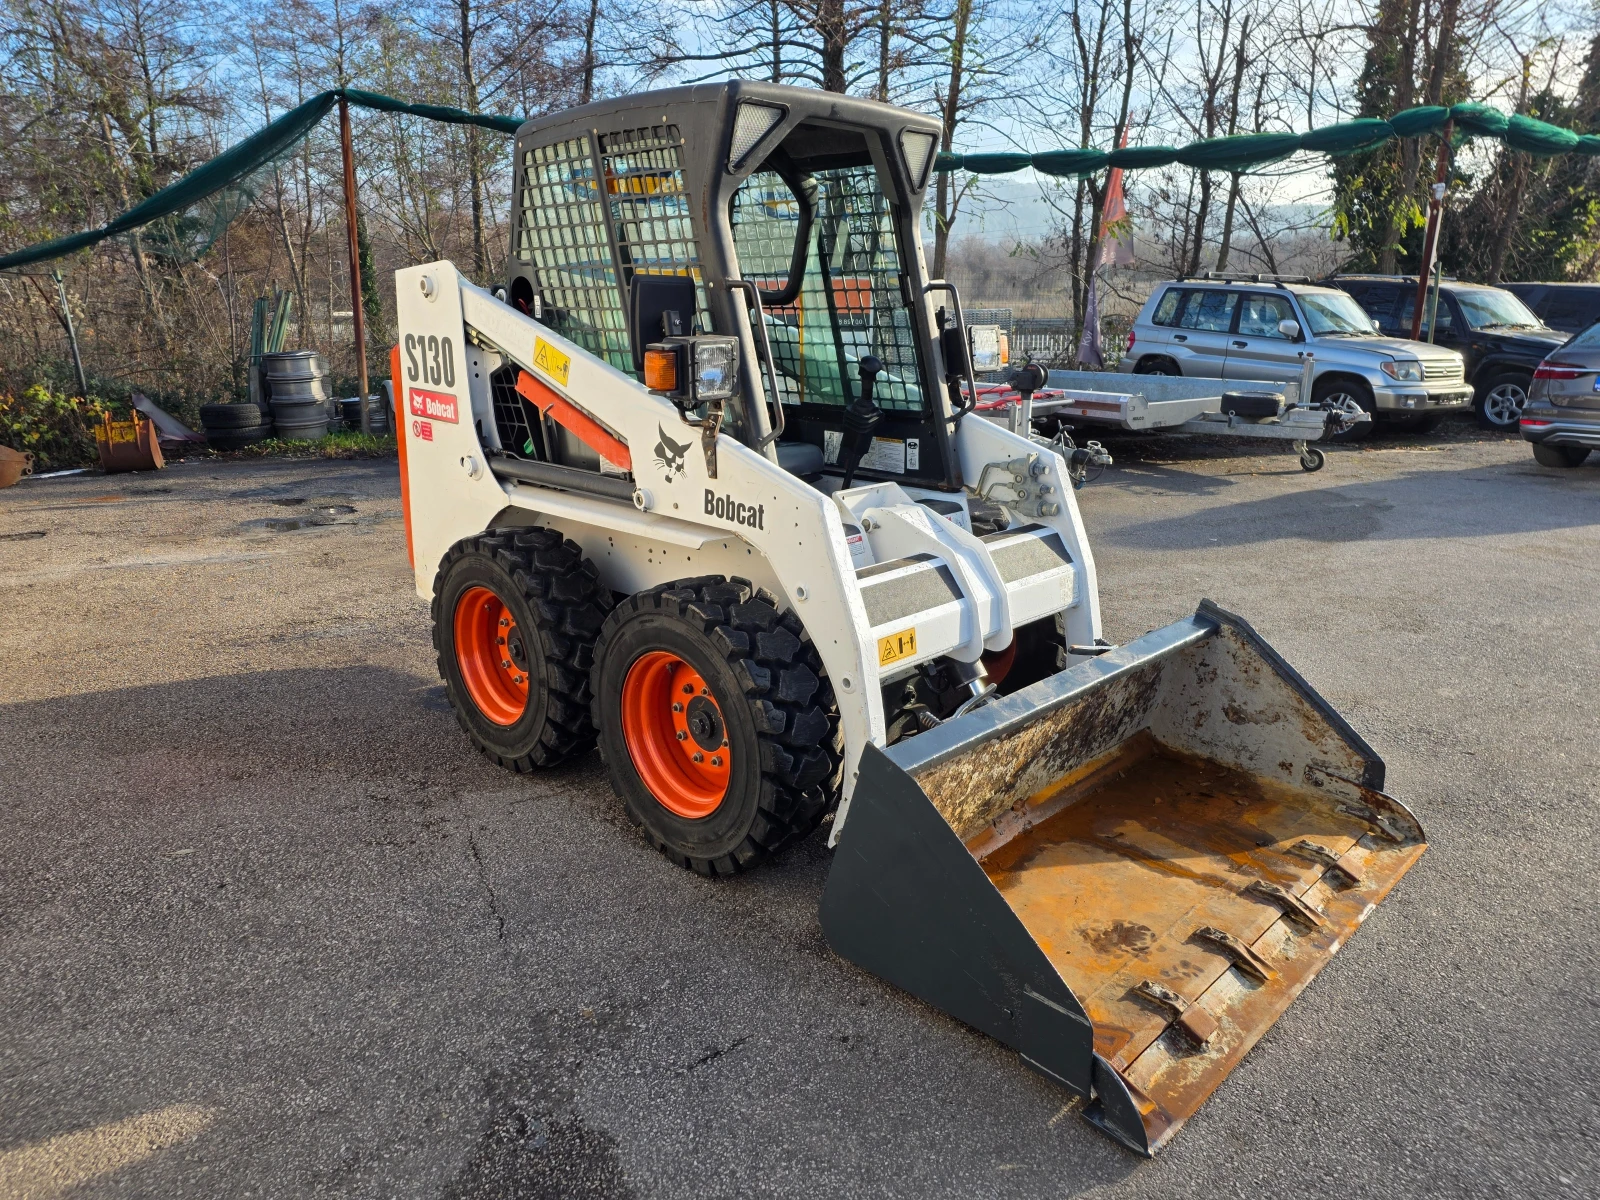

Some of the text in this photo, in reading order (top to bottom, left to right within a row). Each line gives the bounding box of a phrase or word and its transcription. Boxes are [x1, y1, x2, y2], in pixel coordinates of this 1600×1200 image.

[404, 333, 456, 388] S130
[425, 397, 455, 420] Bobcat
[704, 488, 765, 531] Bobcat
